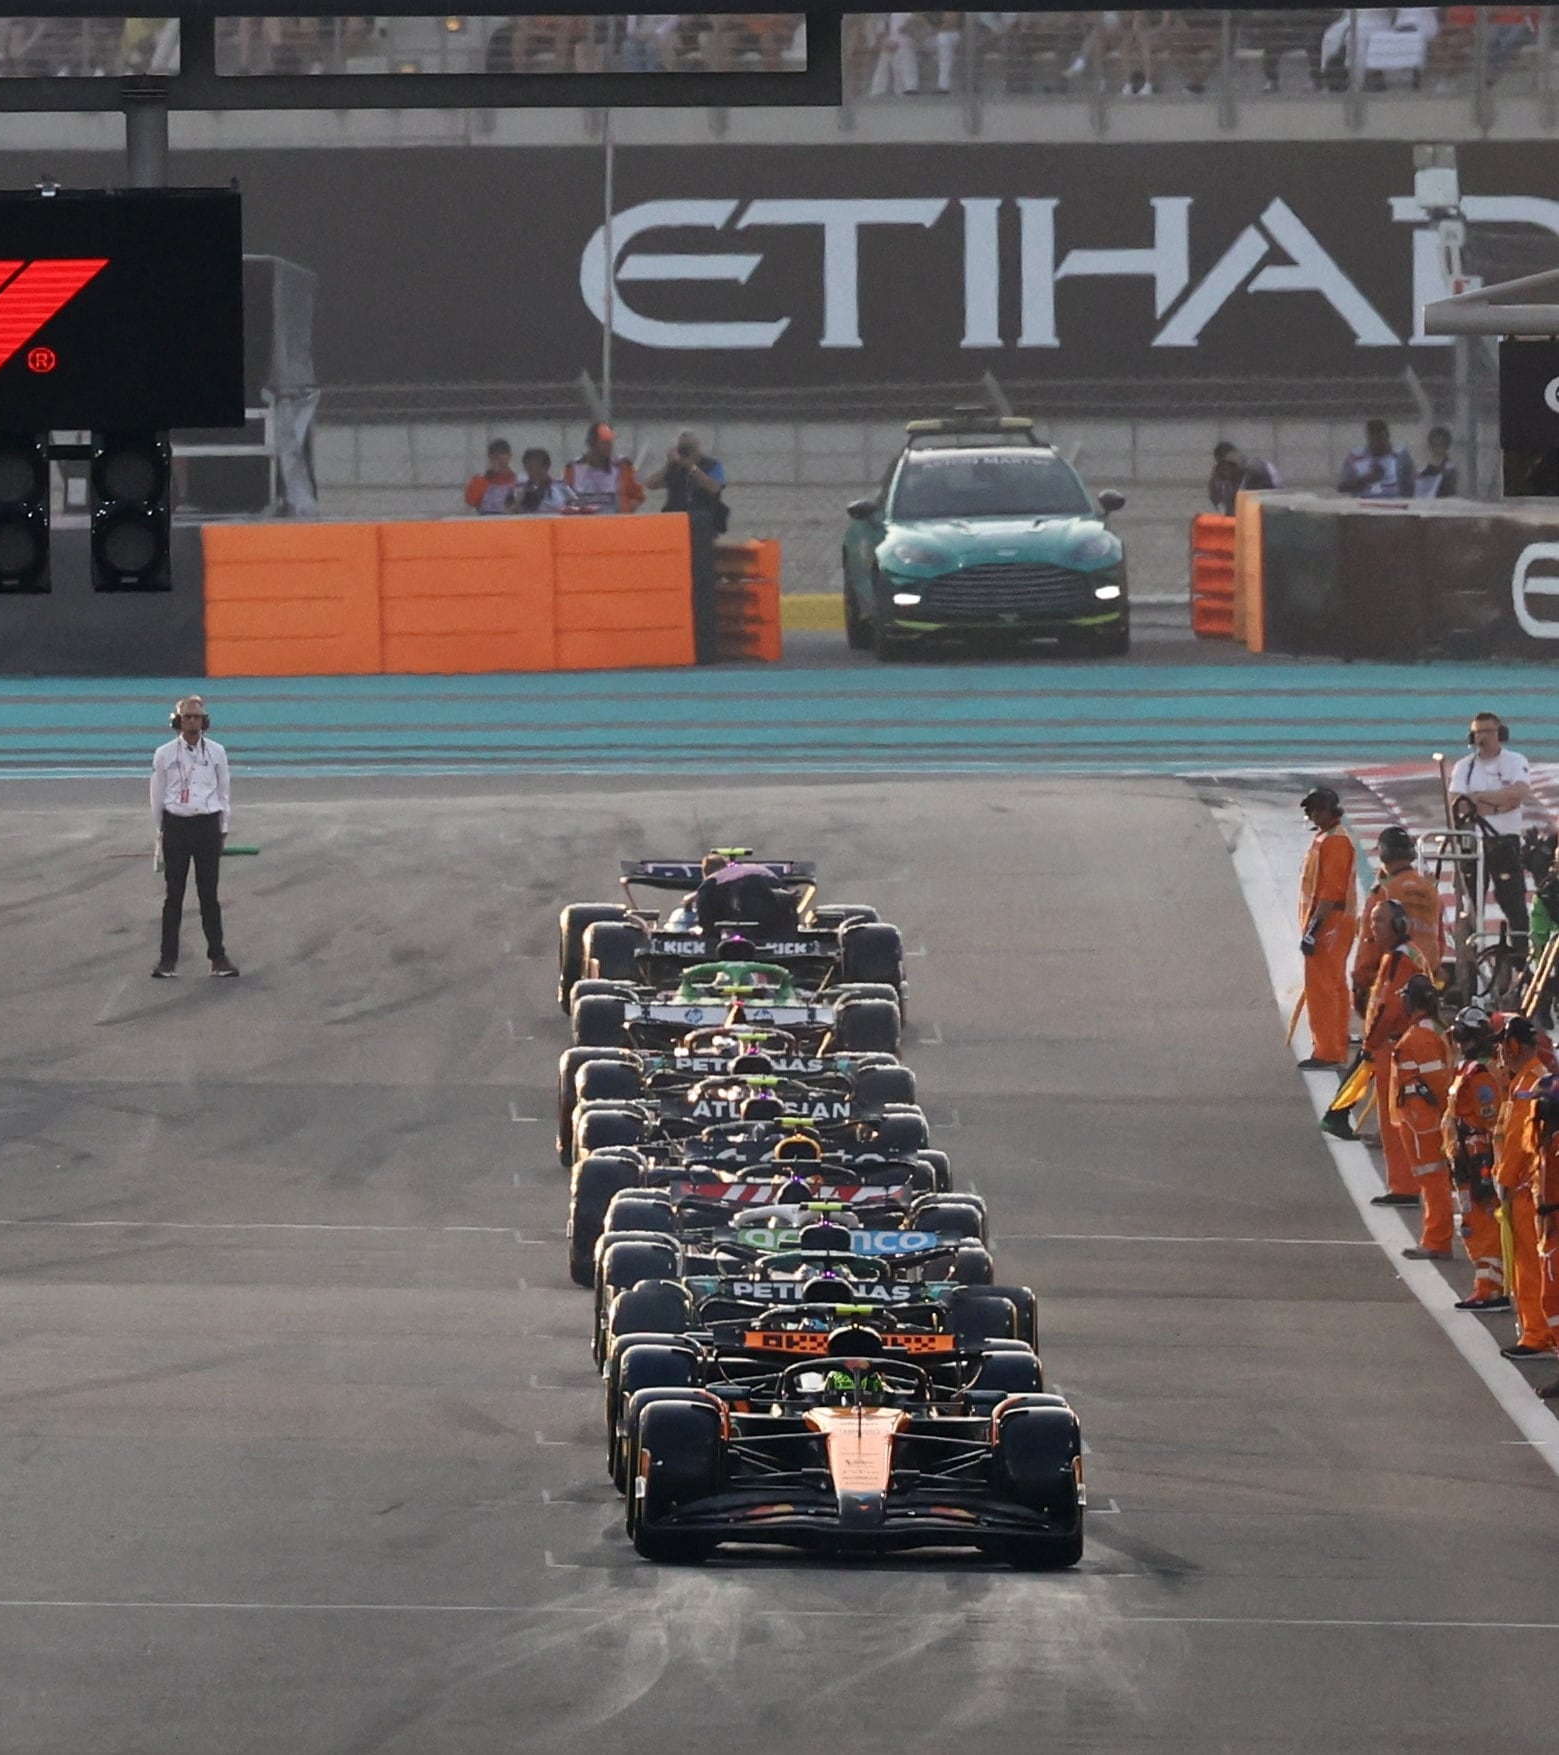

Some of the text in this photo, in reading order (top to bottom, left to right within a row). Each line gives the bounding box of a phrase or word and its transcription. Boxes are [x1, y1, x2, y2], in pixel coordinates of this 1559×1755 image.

[663, 941, 706, 955] KICK
[675, 1057, 824, 1073] PETAS
[692, 1100, 851, 1118] ATLSIAN
[733, 1281, 912, 1301] PETAS
